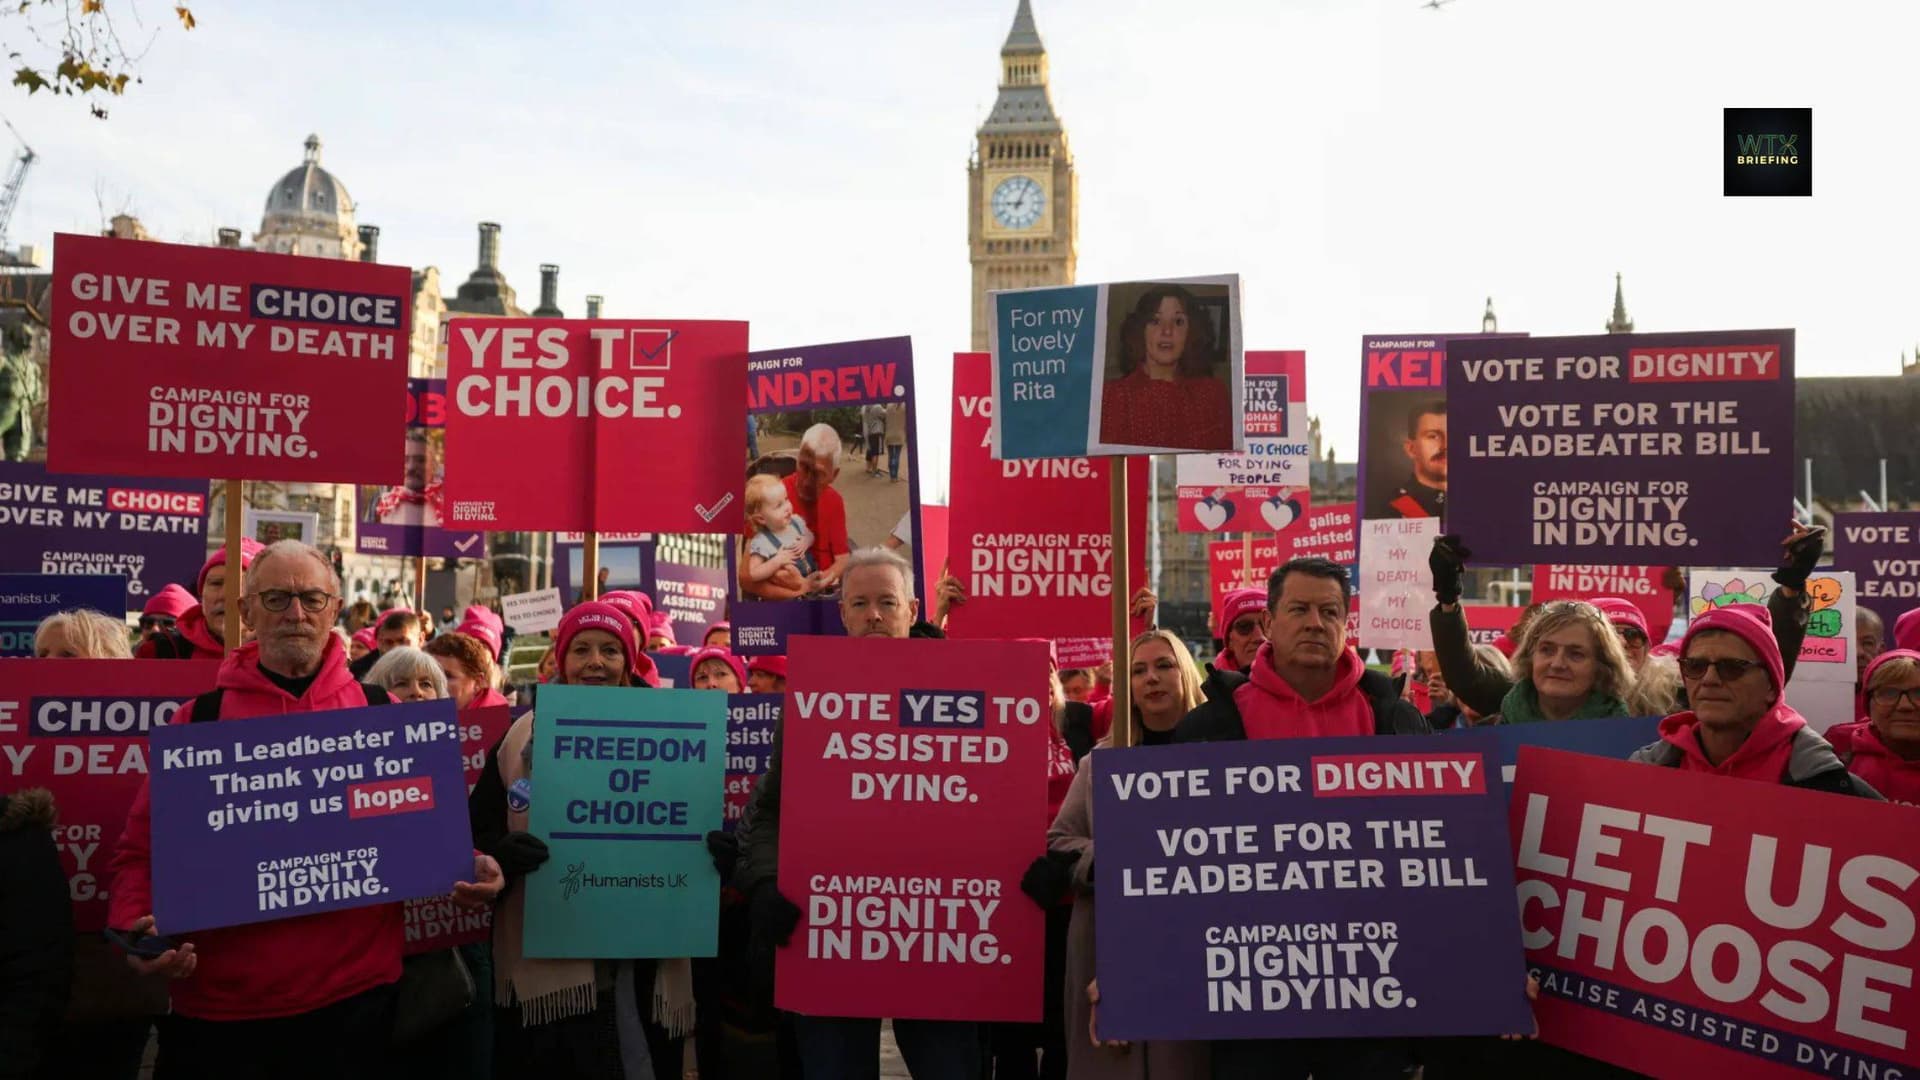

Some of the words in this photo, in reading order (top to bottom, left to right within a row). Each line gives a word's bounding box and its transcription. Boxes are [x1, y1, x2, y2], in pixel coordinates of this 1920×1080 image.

[71, 272, 170, 306] GIVE
[186, 282, 241, 312] ME
[256, 288, 396, 325] CHOICE
[1010, 307, 1047, 329] For
[1051, 306, 1085, 327] my
[69, 311, 180, 345] OVER
[197, 320, 255, 351] MY
[270, 326, 394, 360] DEATH
[1011, 328, 1077, 354] lovely
[1369, 340, 1415, 349] CAMPAIGN
[1417, 339, 1436, 348] FOR
[459, 328, 569, 369] YES
[748, 359, 781, 372] PAIGN
[783, 357, 803, 368] FOR
[1012, 357, 1066, 377] mum
[1367, 351, 1446, 386] KEI
[1462, 357, 1544, 382] VOTE
[1556, 356, 1620, 380] FOR
[1633, 350, 1775, 378] DIGNITY
[150, 386, 262, 407] CAMPAIGN
[269, 393, 310, 409] FOR
[456, 375, 682, 419] CHOICE.
[1012, 380, 1056, 402] Rita
[149, 402, 309, 433] DIGNITY
[1497, 403, 1582, 428] VOTE
[1593, 402, 1659, 426] FOR
[1671, 401, 1738, 425] THE
[1246, 423, 1277, 432] OTTS
[148, 428, 186, 453] IN
[194, 430, 318, 460] DYING.
[1249, 444, 1264, 455] TO
[1266, 443, 1309, 456] CHOICE
[1469, 433, 1683, 457] LEADBEATER
[1696, 431, 1770, 455] BILL
[1002, 459, 1099, 479] DYING.
[1218, 458, 1241, 469] FOR
[1246, 459, 1292, 470] DYING
[1230, 473, 1282, 484] PEOPLE
[1533, 481, 1639, 496] CAMPAIGN
[1647, 481, 1689, 495] FOR
[0, 482, 57, 504] GIVE
[67, 487, 103, 506] ME
[111, 491, 201, 513] CHOICE
[1533, 497, 1689, 521] DIGNITY
[73, 511, 111, 529] MY
[120, 513, 199, 534] DEATH
[1309, 512, 1351, 530] galise
[1374, 523, 1392, 534] MY
[1398, 522, 1423, 534] LIFE
[972, 534, 1070, 548] CAMPAIGN
[1077, 533, 1112, 548] FOR
[1293, 530, 1353, 548] assisted
[1532, 522, 1567, 545] IN
[1575, 522, 1698, 546] DYING.
[1845, 527, 1910, 543] VOTE
[42, 552, 114, 563] CAMPAIGN
[119, 554, 145, 565] FOR
[971, 549, 1112, 572] DIGNITY
[1389, 549, 1408, 560] MY
[42, 561, 144, 579] DIGNITY
[1377, 571, 1418, 582] DEATH
[656, 579, 685, 592] VOTE
[687, 583, 710, 596] YES
[711, 586, 725, 599] TO
[971, 573, 1007, 597] IN
[1549, 574, 1575, 590] IN
[1578, 575, 1657, 595] DYING.
[44, 594, 60, 604] UK
[662, 595, 716, 611] ASSISTED
[1388, 597, 1407, 608] MY
[669, 610, 706, 624] DYING.
[1371, 617, 1422, 631] CHOICE
[738, 631, 775, 639] DIGNITY
[749, 638, 779, 646] DYING.
[1471, 630, 1502, 642] YES
[0, 701, 19, 732] E
[794, 692, 891, 721] VOTE
[904, 695, 979, 723] YES
[992, 698, 1040, 725] TO
[163, 746, 223, 769] Kim
[235, 727, 394, 764] Leadbeater
[405, 721, 456, 744] MP:
[554, 735, 707, 763] FREEDOM
[822, 732, 1009, 763] ASSISTED
[2, 745, 36, 776] Y
[54, 744, 149, 776] DEA
[210, 767, 301, 796] Thank
[312, 762, 363, 789] you
[374, 754, 414, 777] for
[608, 768, 650, 793] OF
[1111, 769, 1211, 800] VOTE
[1225, 765, 1302, 796] FOR
[1316, 760, 1477, 791] DIGNITY
[851, 773, 979, 803] DYING.
[207, 801, 299, 831] giving
[310, 796, 343, 815] us
[354, 784, 430, 813] hope.
[566, 800, 689, 826] CHOICE
[1156, 826, 1259, 857] VOTE
[1274, 822, 1352, 852] FOR
[1366, 820, 1446, 849] THE
[257, 849, 340, 872] CAMPAIGN
[347, 846, 378, 860] FOR
[257, 858, 378, 892] DIGNITY
[582, 873, 665, 889] Humanists
[667, 873, 688, 888] UK
[1122, 858, 1385, 897] LEADBEATER
[1400, 858, 1488, 888] BILL
[1517, 793, 1713, 903] LET
[1744, 833, 1920, 951] US
[258, 889, 287, 911] IN
[293, 878, 389, 906] DYING.
[809, 875, 942, 897] CAMPAIGN
[952, 879, 1001, 897] FOR
[808, 895, 1000, 930] DIGNITY
[1205, 923, 1337, 945] CAMPAIGN
[1348, 922, 1398, 941] FOR
[807, 929, 851, 960] IN
[861, 931, 1012, 965] DYING.
[1206, 942, 1399, 979] DIGNITY
[1516, 879, 1914, 1050] CHOOSE
[1208, 980, 1252, 1012] IN
[1262, 977, 1417, 1011] DYING.
[1632, 997, 1780, 1054] ASSISTED
